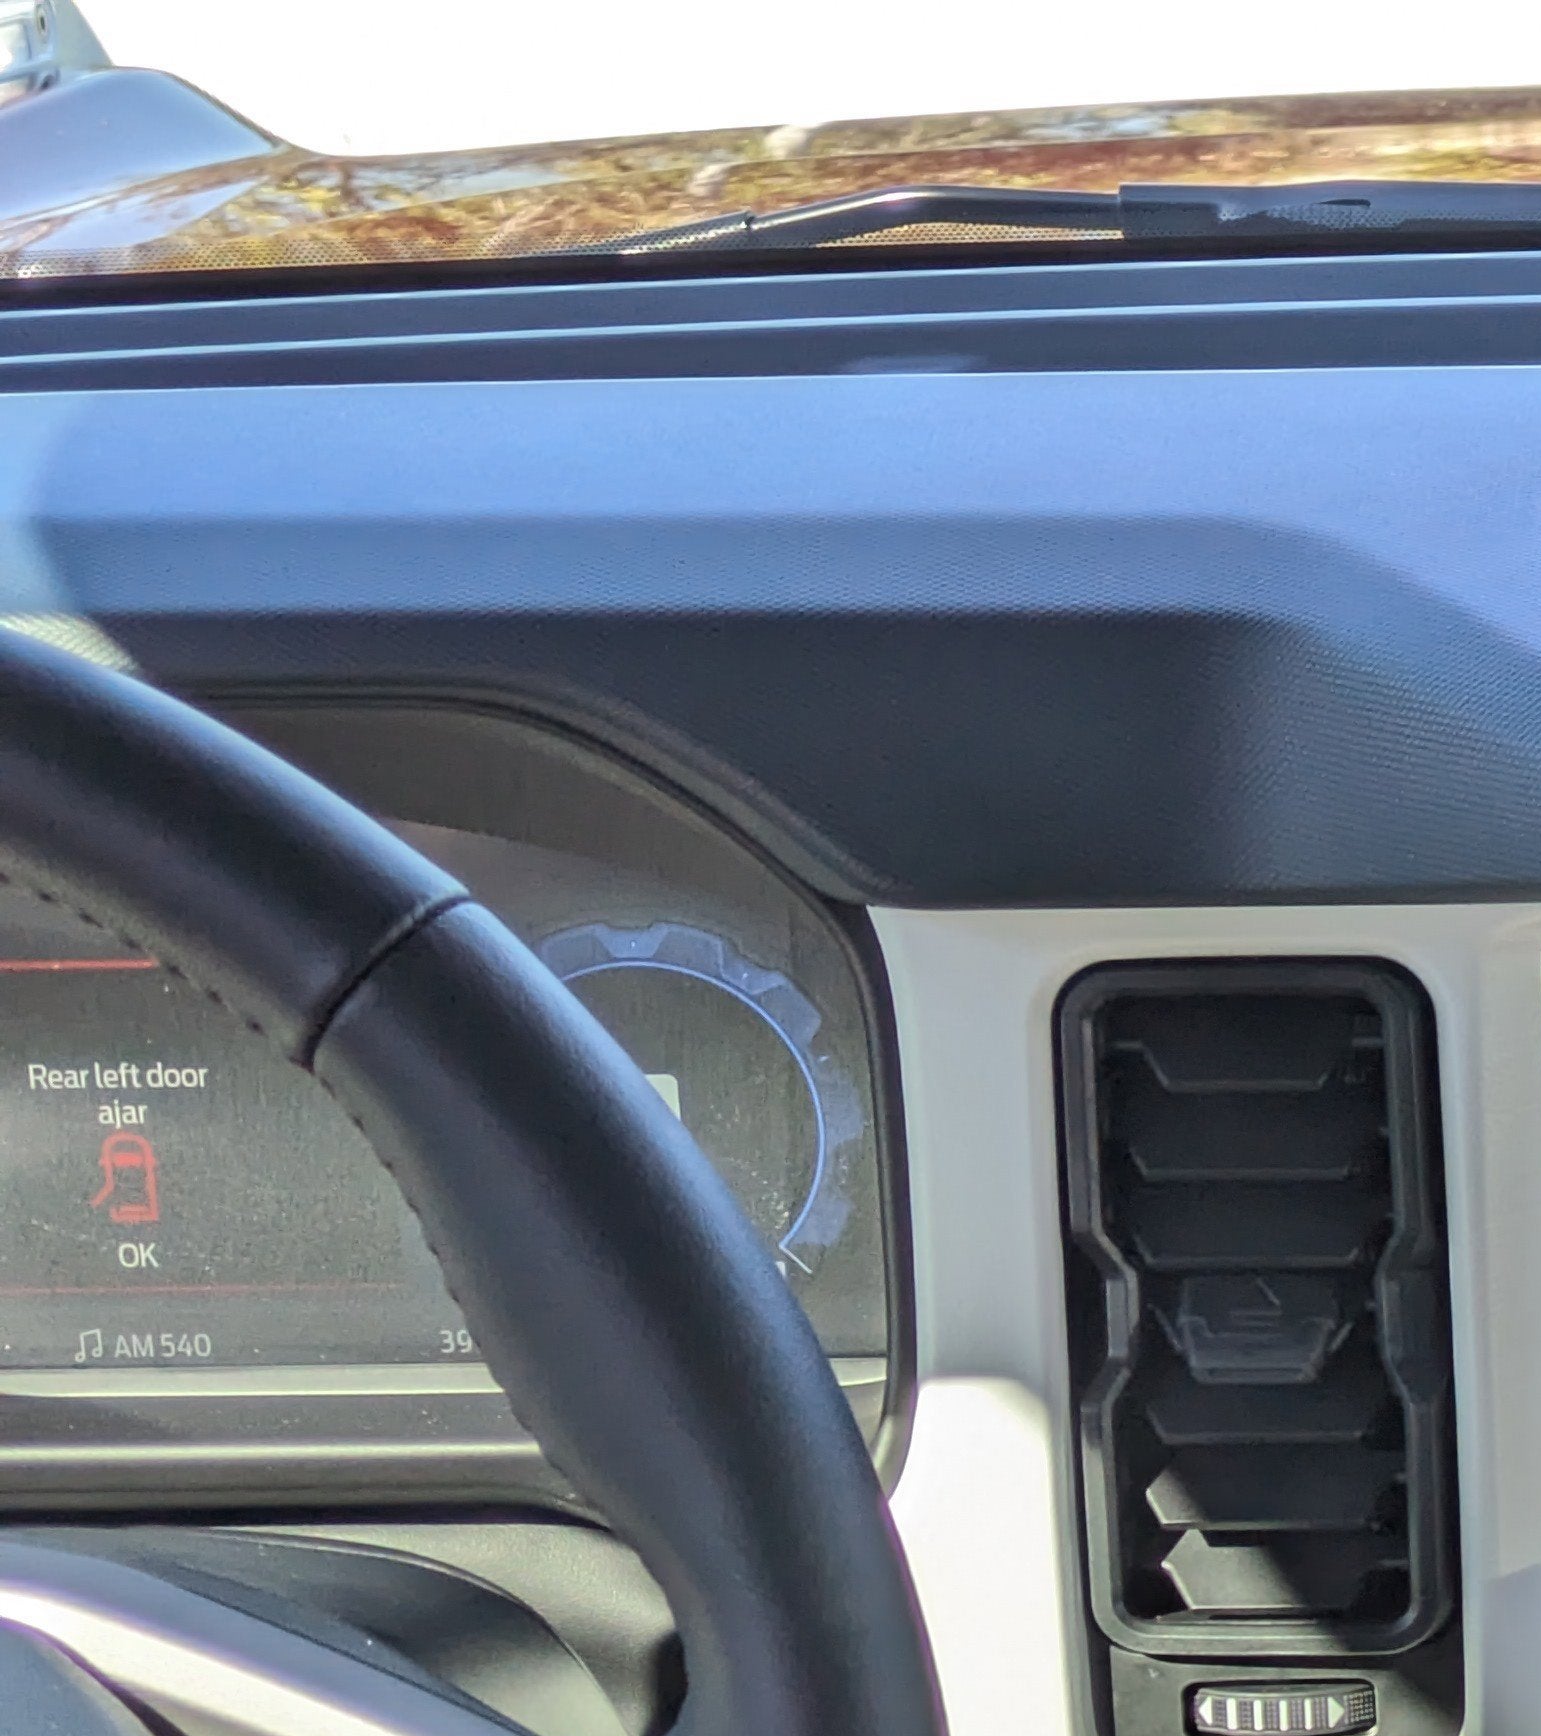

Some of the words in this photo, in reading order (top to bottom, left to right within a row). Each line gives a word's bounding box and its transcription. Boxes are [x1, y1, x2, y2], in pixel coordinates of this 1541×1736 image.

[27, 1063, 90, 1090] Rear
[93, 1061, 143, 1089] left
[145, 1061, 208, 1089] door
[98, 1099, 148, 1128] ajar
[117, 1242, 160, 1269] OK
[114, 1333, 155, 1358] AM
[160, 1333, 212, 1358] 540
